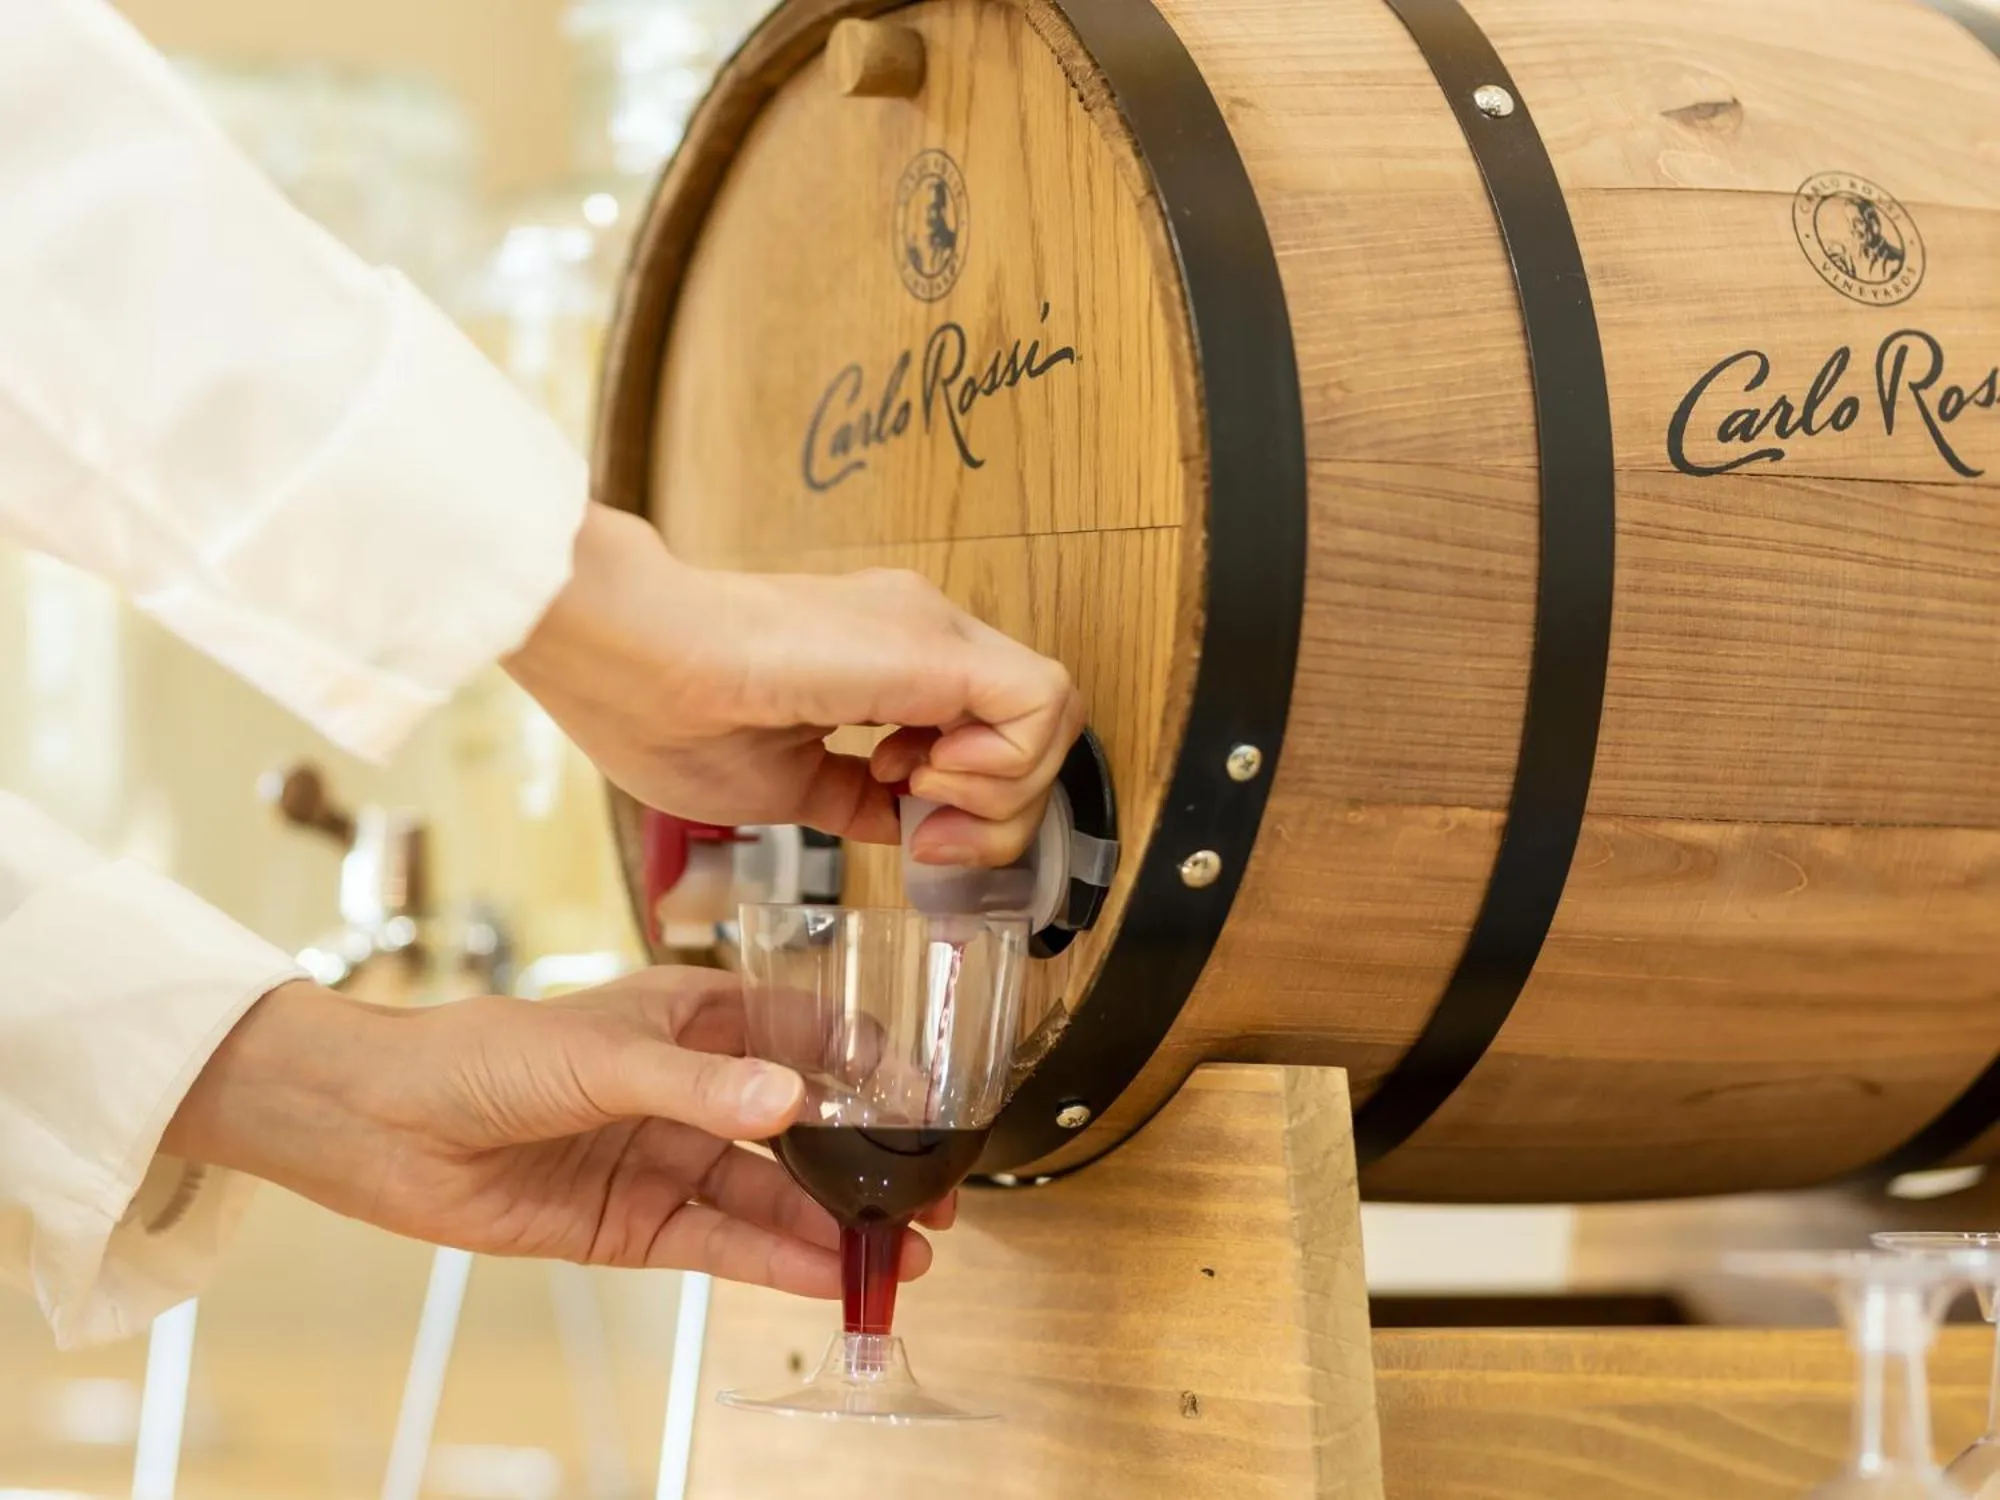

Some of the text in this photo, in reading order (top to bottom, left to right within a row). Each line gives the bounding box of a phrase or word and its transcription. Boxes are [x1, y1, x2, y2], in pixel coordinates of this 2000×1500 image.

[803, 301, 1075, 492] Carlo Rossi
[1666, 328, 2000, 478] Carlo Ros
